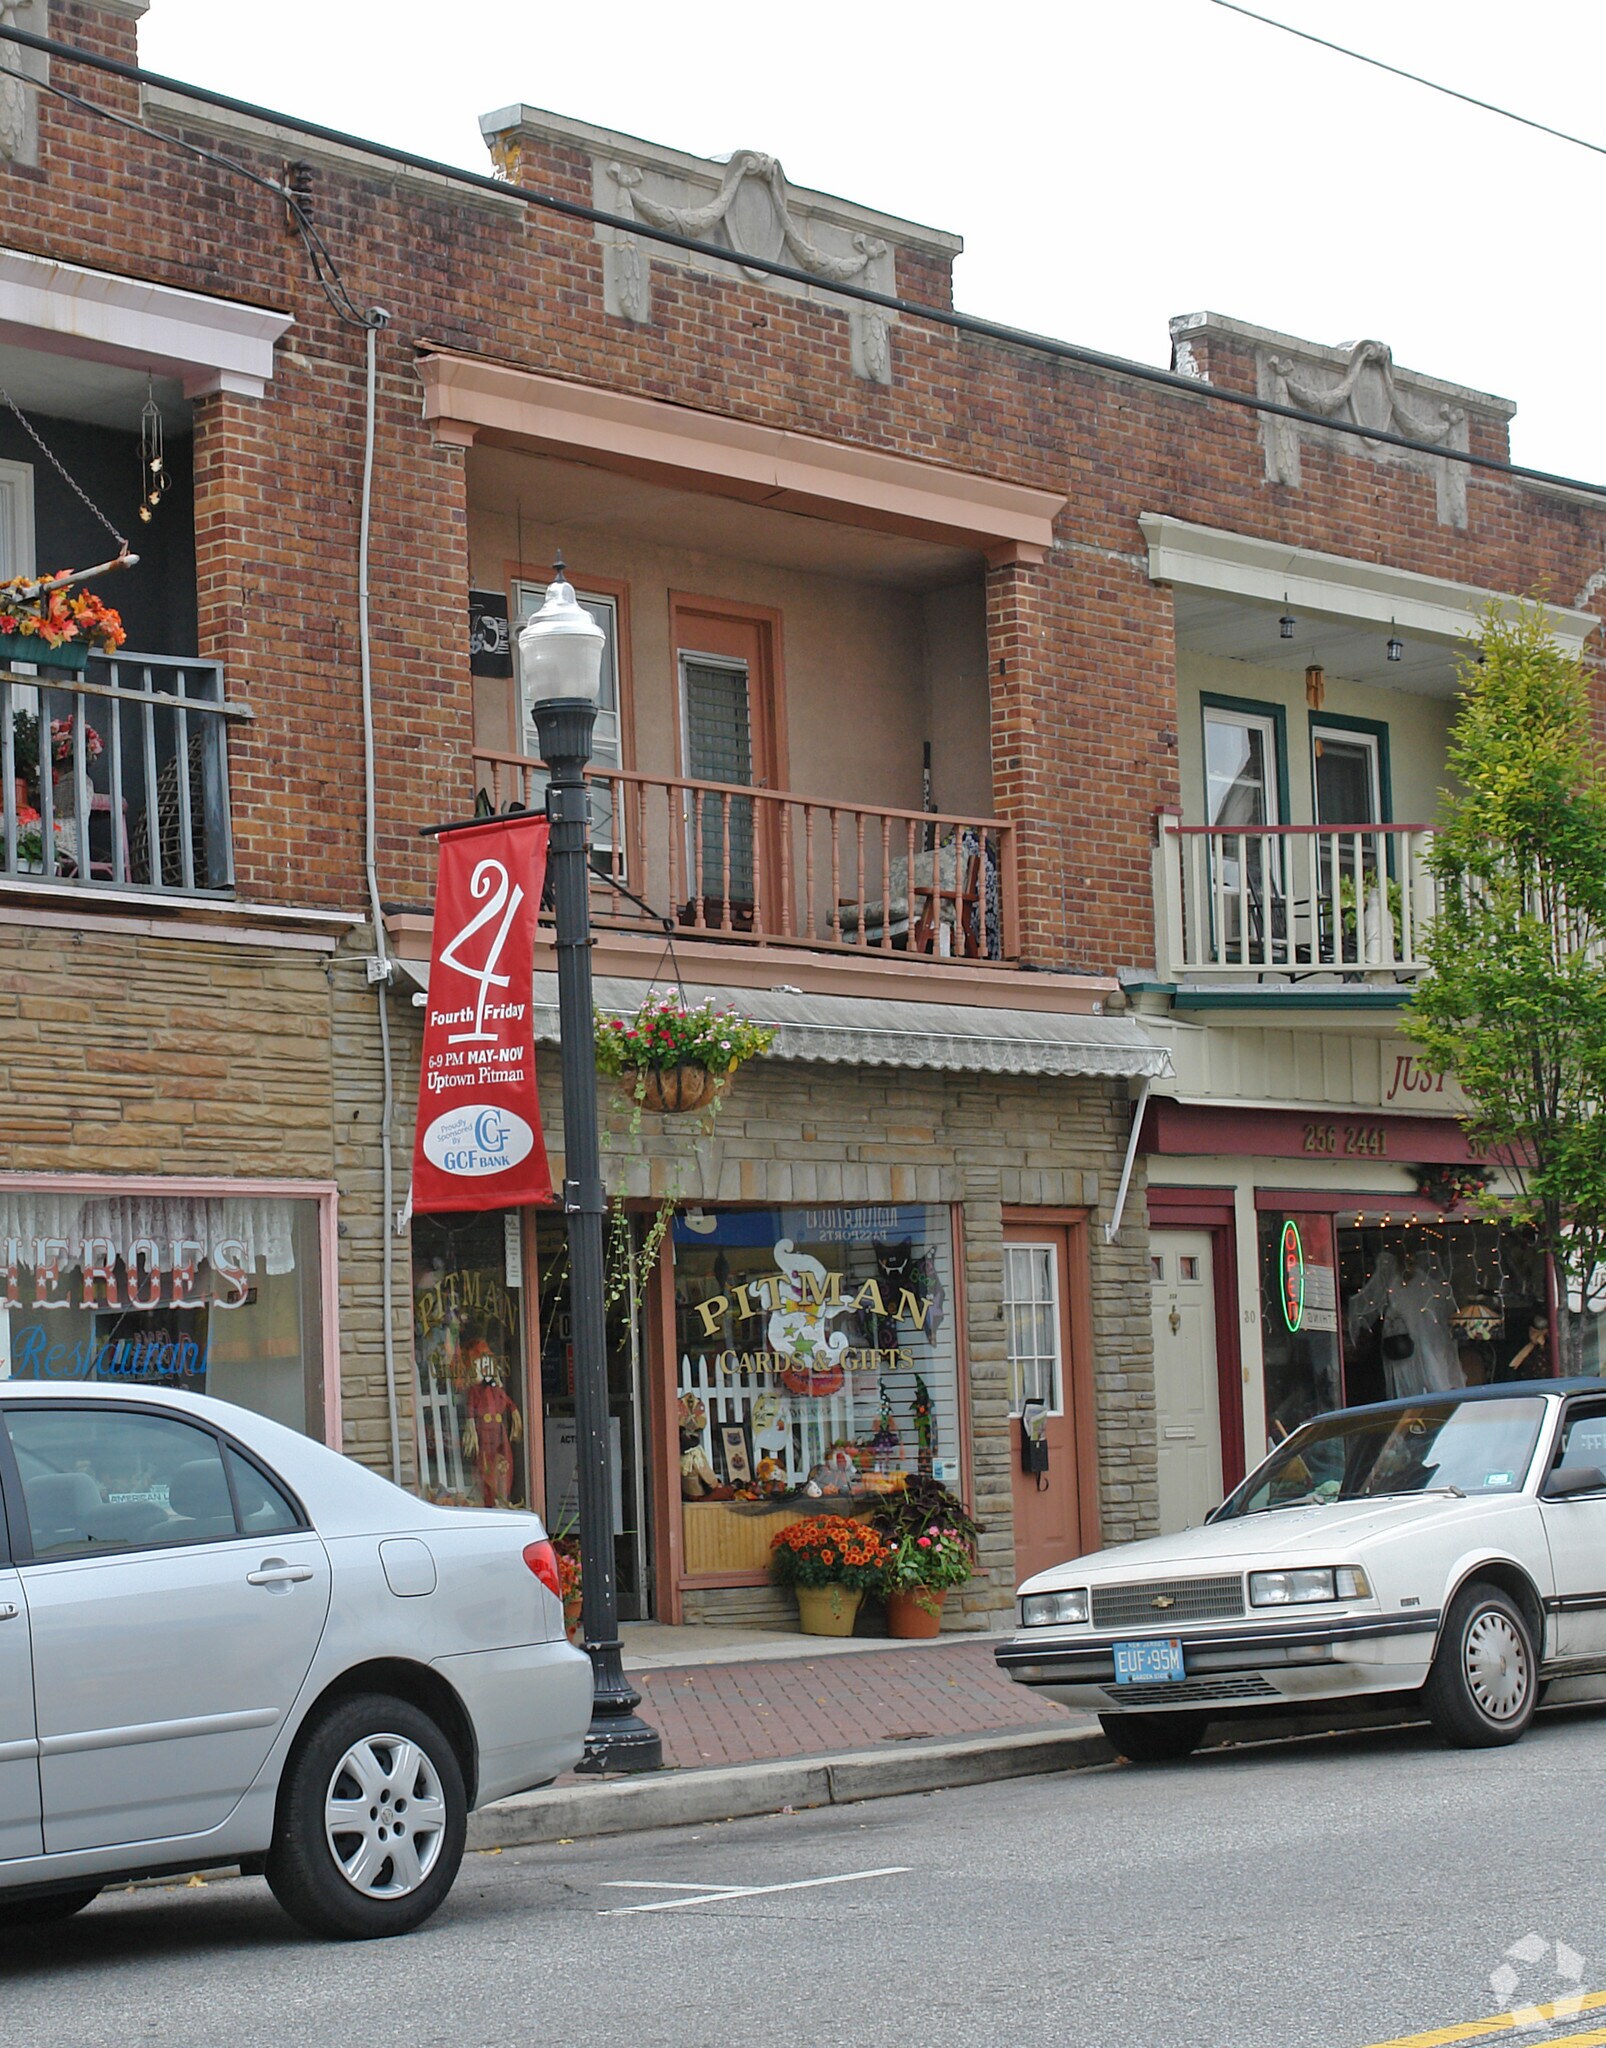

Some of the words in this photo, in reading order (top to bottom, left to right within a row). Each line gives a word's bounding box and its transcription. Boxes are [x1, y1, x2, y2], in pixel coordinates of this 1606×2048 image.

[430, 1006, 474, 1027] Fourth
[484, 1003, 525, 1020] Friday
[428, 1054, 443, 1069] 6-9
[444, 1051, 465, 1067] PM
[467, 1046, 524, 1065] MAY-NOV
[427, 1071, 475, 1094] Uptown
[478, 1066, 525, 1084] Pitman
[437, 1123, 473, 1142] Sponsored
[441, 1119, 467, 1134] Proudly
[1304, 1124, 1337, 1153] 256
[1345, 1127, 1388, 1156] 2441
[444, 1150, 478, 1170] GCF
[480, 1156, 511, 1168] BANK
[1284, 1228, 1299, 1325] OPEN
[418, 1269, 519, 1337] PITMAN
[694, 1271, 934, 1338] PITMAN
[719, 1349, 806, 1375] CARDS
[813, 1349, 832, 1372] &
[840, 1347, 915, 1372] GIFTS
